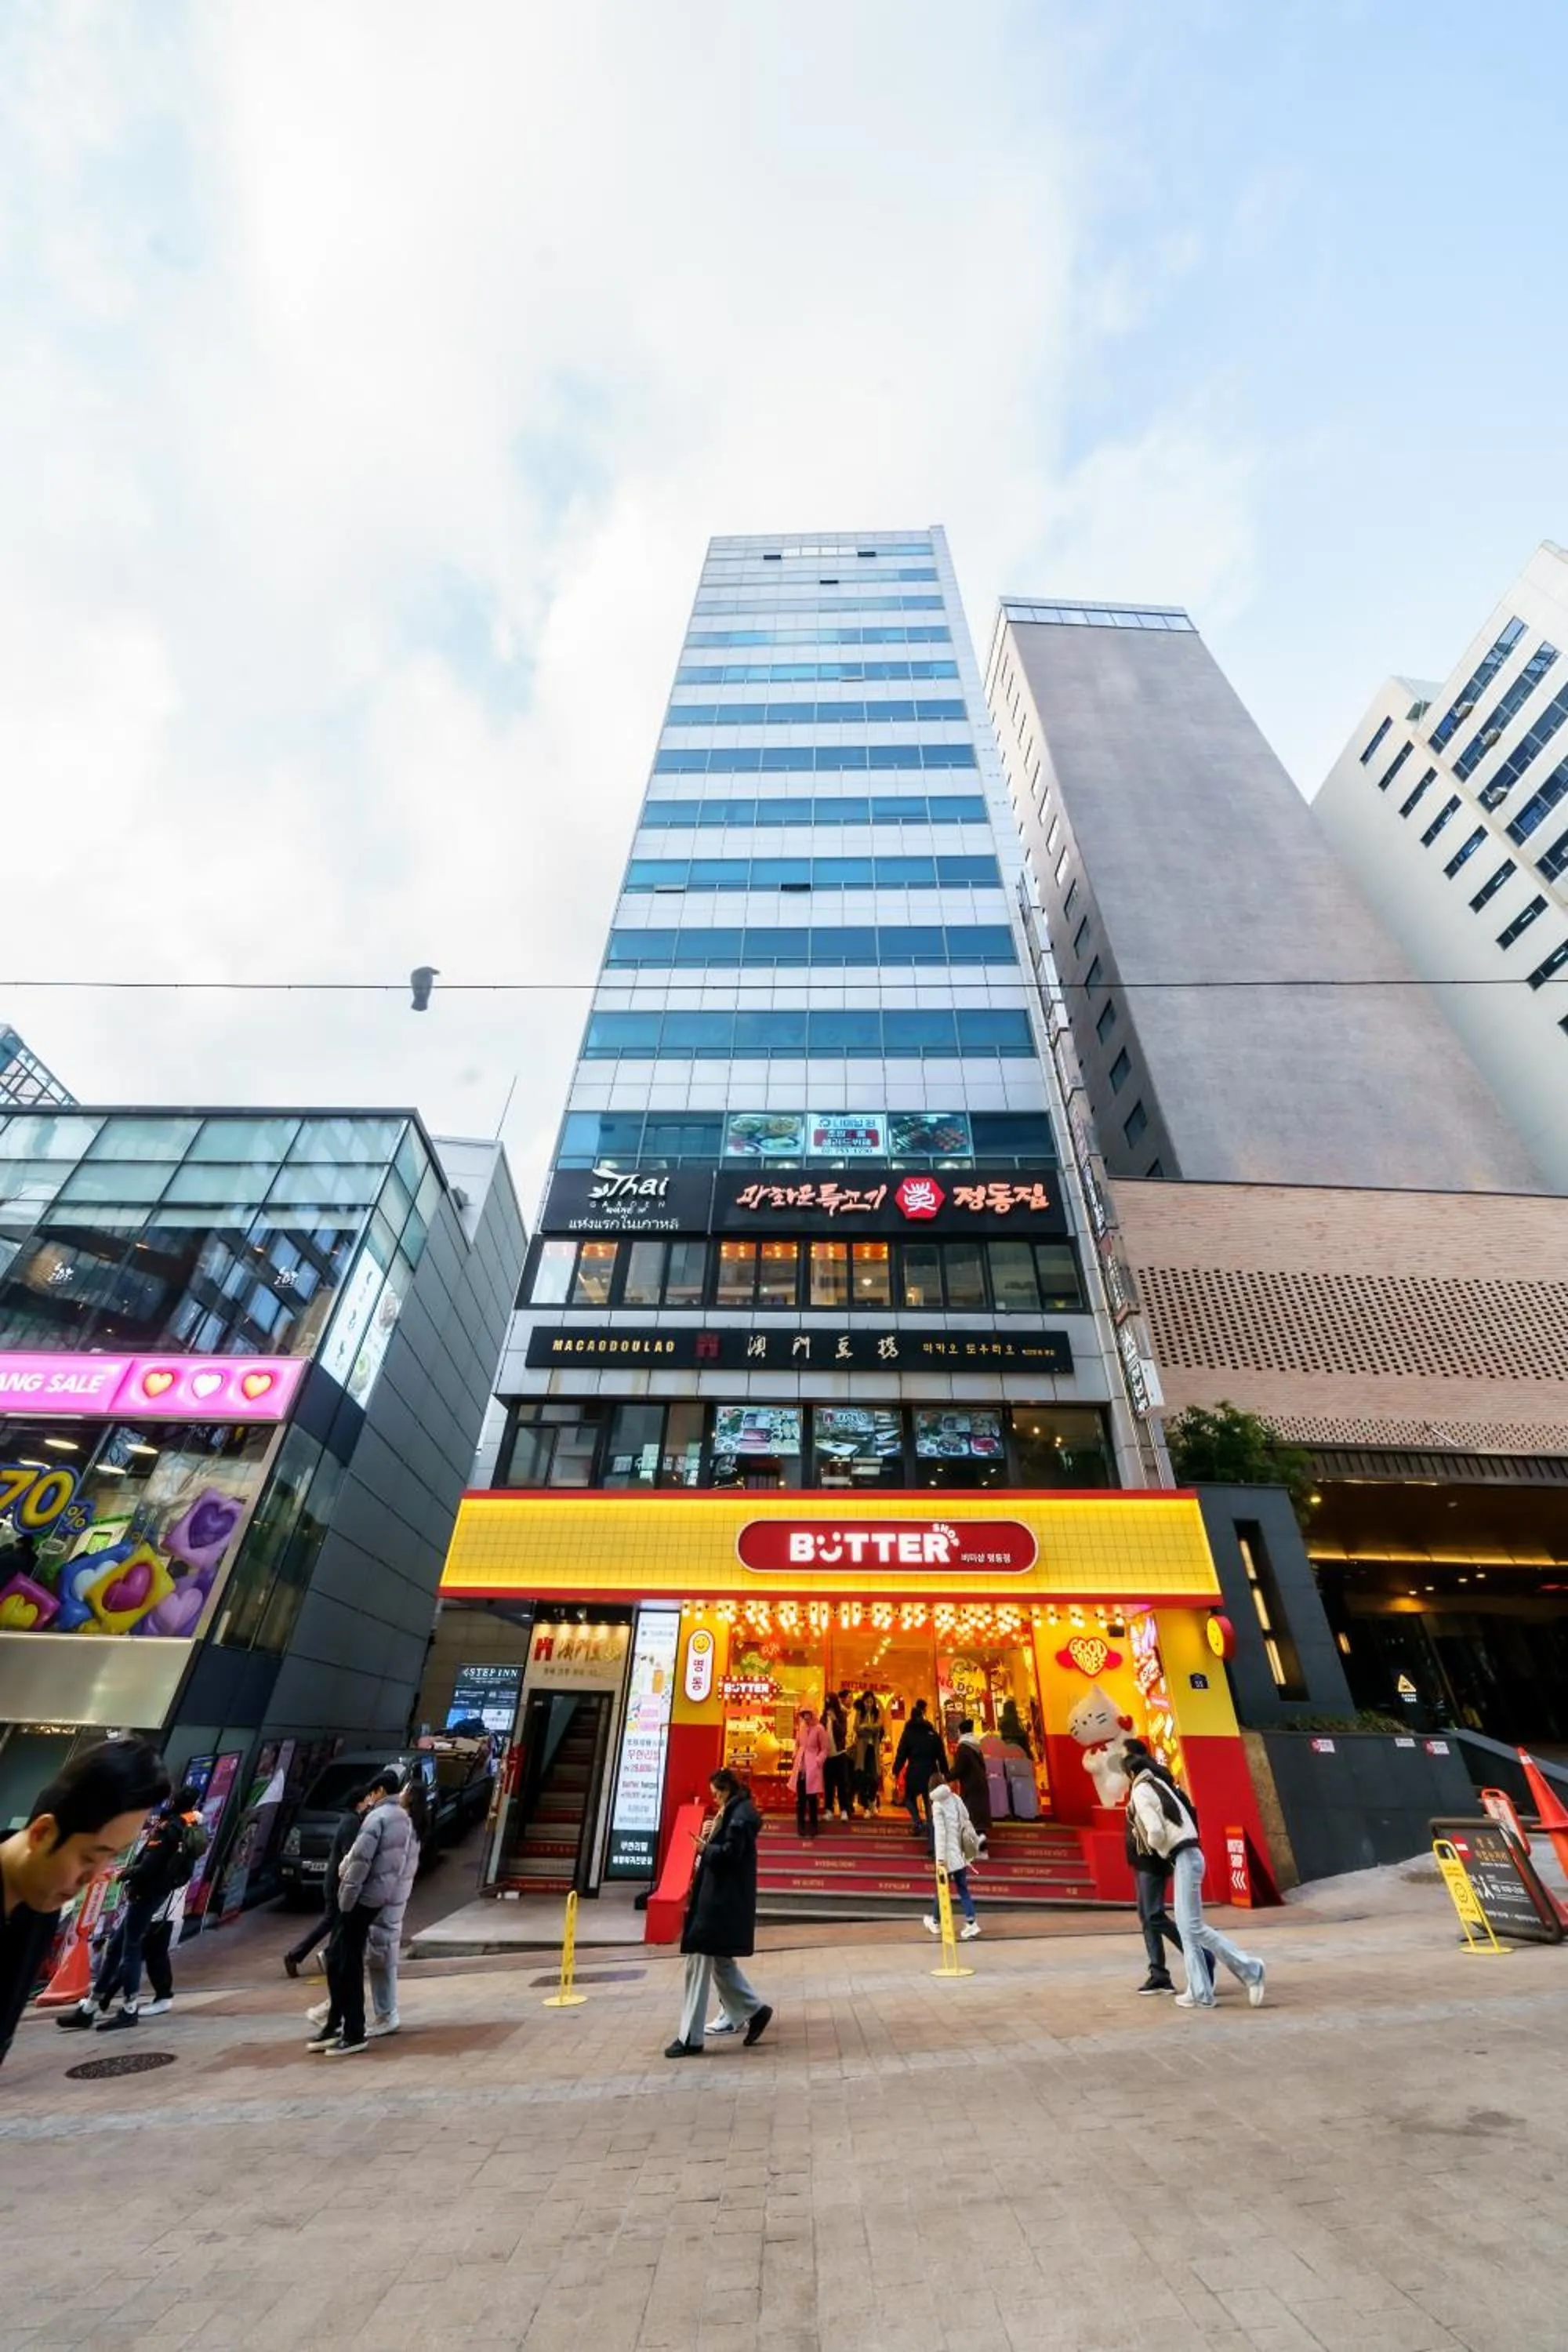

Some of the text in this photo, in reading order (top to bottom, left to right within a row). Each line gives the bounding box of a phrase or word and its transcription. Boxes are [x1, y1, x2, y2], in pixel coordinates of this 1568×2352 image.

[588, 1167, 670, 1197] Thai
[552, 1339, 676, 1352] MACAODOULAO
[45, 1374, 105, 1393] SALE
[789, 1531, 952, 1563] BUTTER
[1069, 1638, 1109, 1657] GOOD
